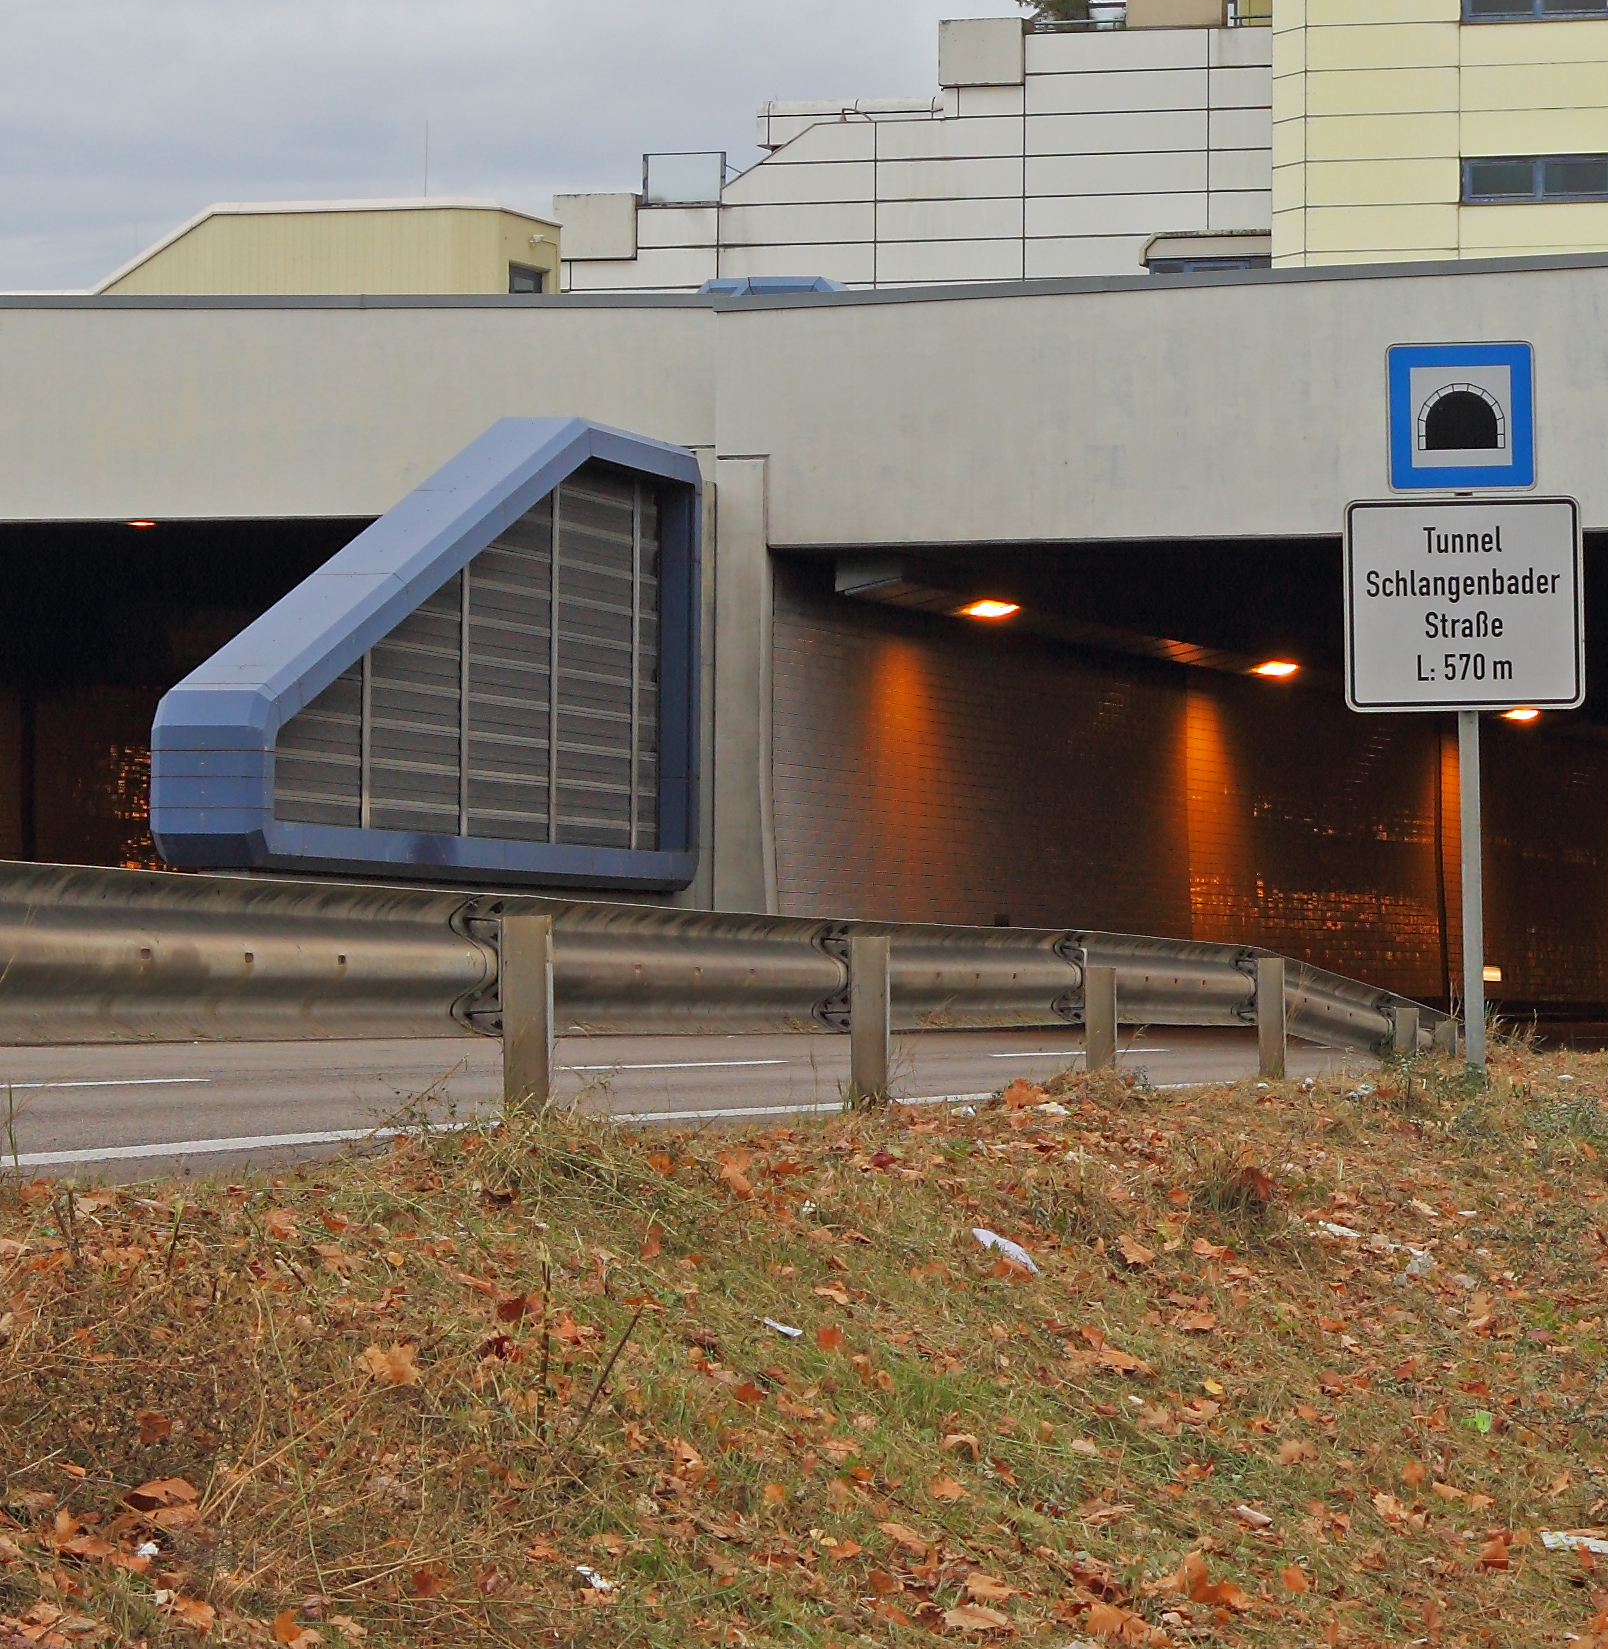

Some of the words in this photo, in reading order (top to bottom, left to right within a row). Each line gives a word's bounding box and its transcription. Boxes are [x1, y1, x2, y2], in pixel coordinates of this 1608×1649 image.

[1422, 525, 1503, 554] Tunnel
[1366, 567, 1561, 603] Schlangenbader
[1425, 610, 1504, 639] Straße
[1417, 654, 1436, 681] L:
[1444, 653, 1486, 681] 570
[1492, 659, 1513, 680] m
